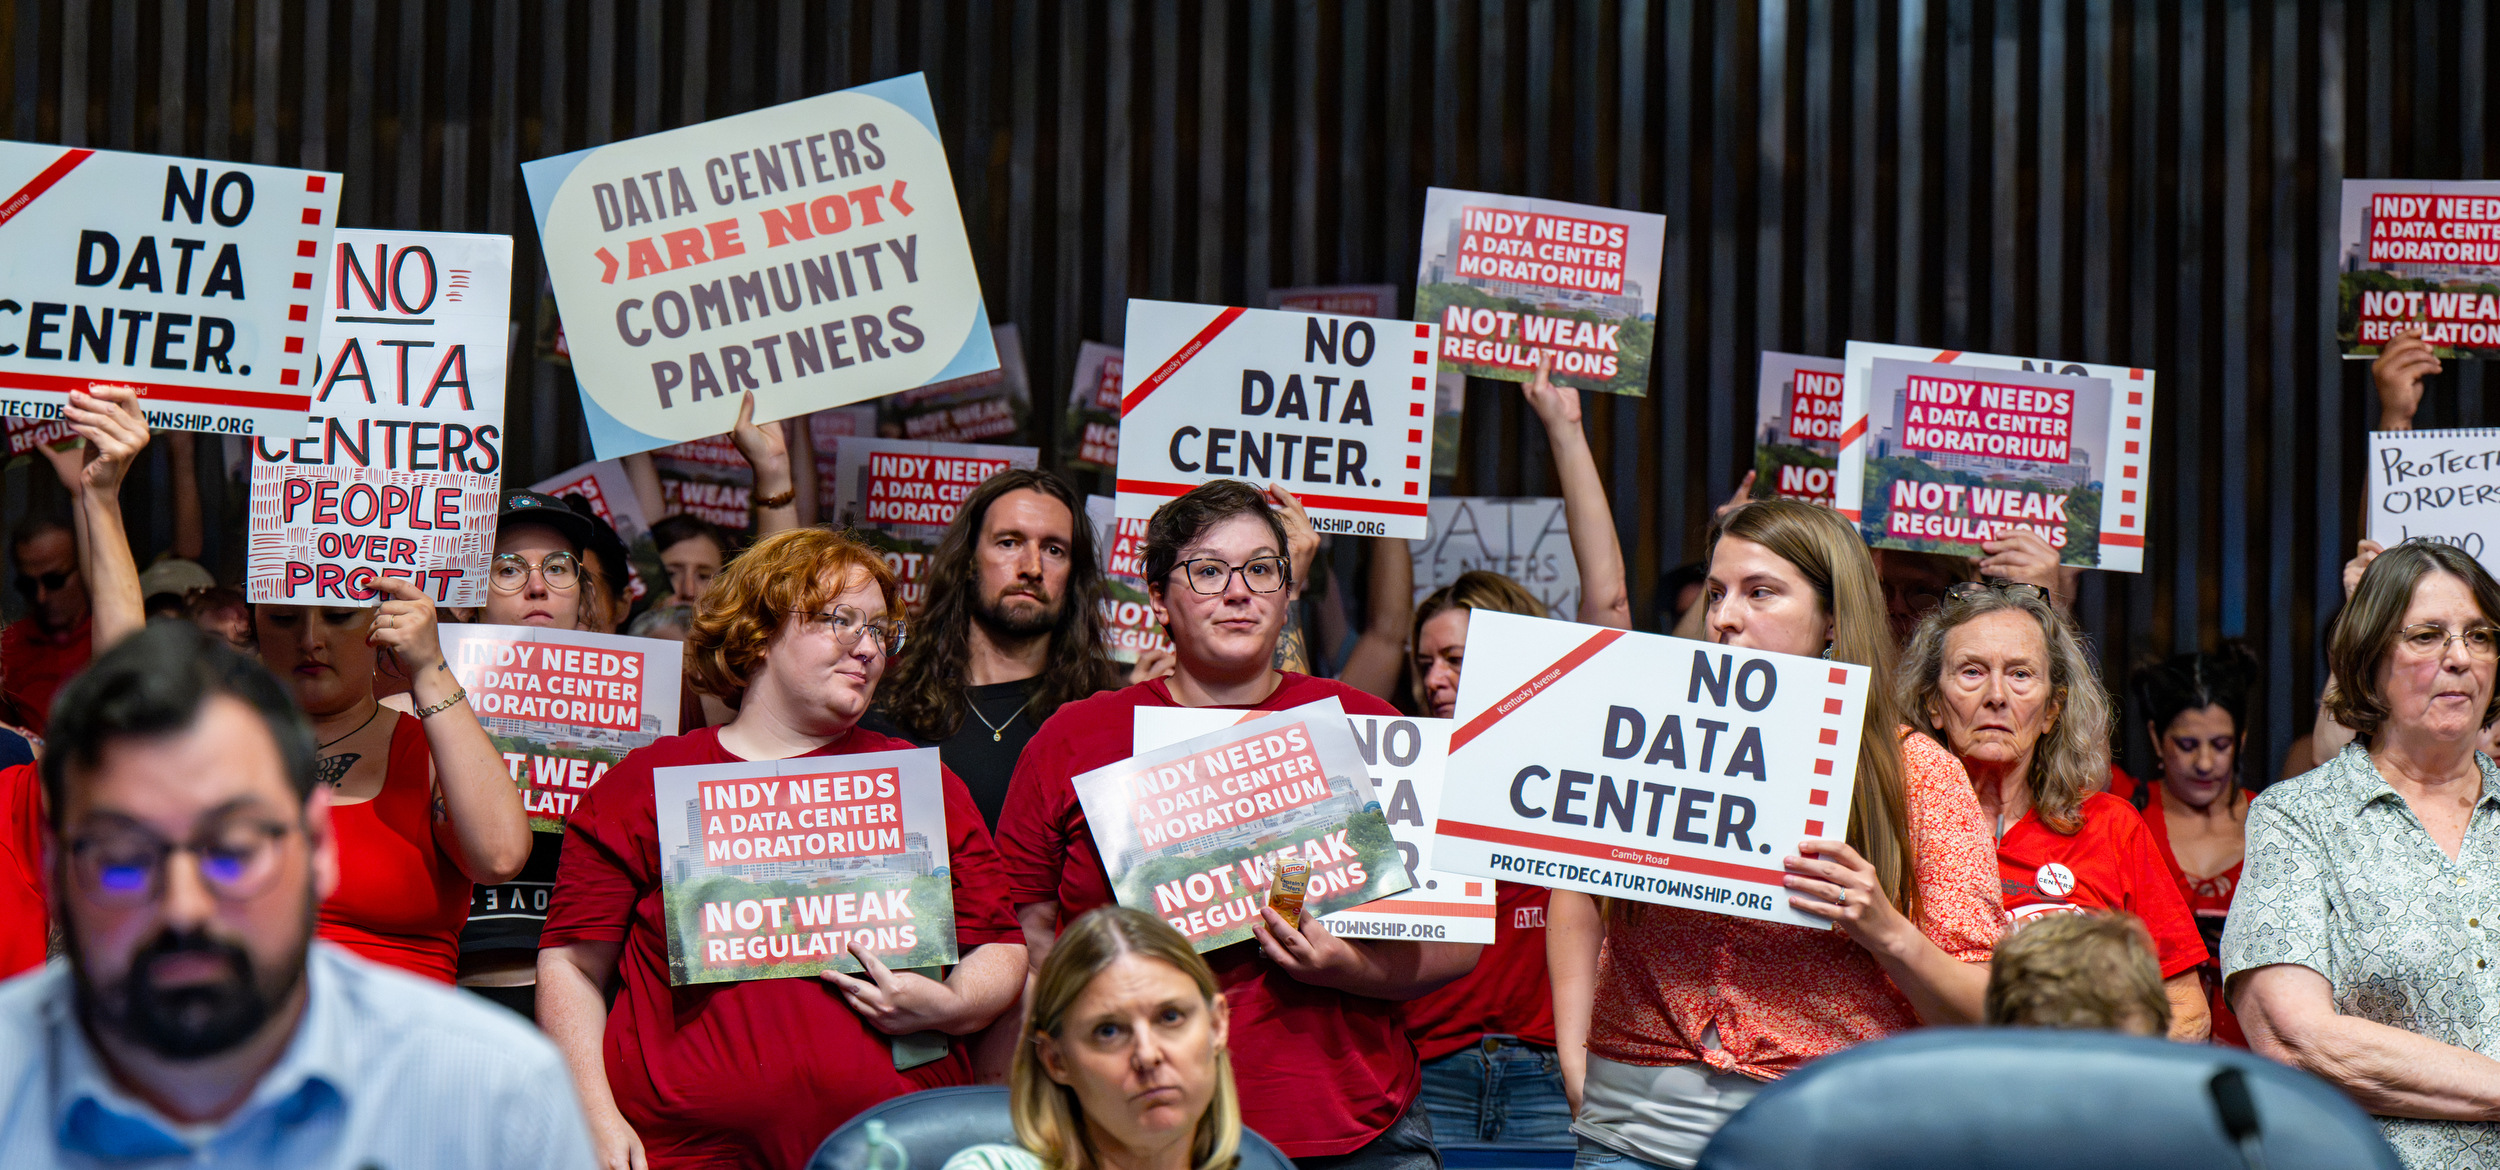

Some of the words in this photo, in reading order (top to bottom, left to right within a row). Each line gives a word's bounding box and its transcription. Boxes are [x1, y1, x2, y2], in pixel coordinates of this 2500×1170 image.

[593, 166, 697, 232] DATA
[705, 122, 886, 205] CENTERS
[162, 165, 255, 228] NO
[2374, 197, 2432, 218] INDY
[627, 217, 746, 281] ARE
[760, 184, 886, 248] NOT
[1464, 210, 1530, 236] INDY
[1535, 217, 1624, 249] NEEDS
[2373, 221, 2387, 238] A
[2390, 222, 2437, 239] DATA
[75, 229, 246, 301] DATA
[1463, 235, 1478, 251] A
[1483, 237, 1534, 258] DATA
[1539, 243, 1621, 269] CENTER
[2372, 241, 2500, 262] MORATORIU
[336, 242, 438, 315] NO
[615, 234, 919, 347] COMMUNITY
[1460, 255, 1621, 291] MORATORIUM
[2364, 290, 2424, 318] NOT
[2429, 292, 2500, 320] WEA
[1305, 316, 1376, 367] NO
[1446, 305, 1518, 338] NOT
[1523, 314, 1620, 351] WEAK
[312, 337, 475, 411] ATA
[651, 305, 925, 409] PARTNERS
[1152, 358, 1181, 384] Kentucky
[1179, 340, 1202, 361] Avenue
[1241, 369, 1374, 426] DATA
[1796, 372, 1844, 397] IND
[1909, 379, 1976, 406] INDY
[1980, 386, 2070, 415] NEEDS
[1795, 397, 1809, 414] A
[1813, 399, 1843, 417] DA
[1908, 405, 1924, 423] A
[1928, 407, 1980, 429] DATA
[1985, 412, 2068, 437] CENTER
[1169, 426, 1381, 488] CENTER.
[1906, 426, 2067, 460] MORATORIUM
[872, 456, 930, 480] INDY
[283, 478, 462, 530] PEOPLE
[871, 480, 885, 497] A
[889, 482, 935, 500] DATA
[1894, 479, 1966, 512] NOT
[1971, 486, 2069, 523] WEAK
[869, 500, 958, 523] MORATO
[318, 533, 417, 565] OVER
[1116, 537, 1130, 553] A
[463, 643, 535, 669] INDY
[542, 648, 639, 679] NEEDS
[463, 671, 478, 687] A
[484, 671, 541, 692] DATA
[547, 676, 637, 702] CENTER
[1496, 687, 1534, 715] Kentucky
[1532, 667, 1562, 691] Avenue
[1687, 649, 1777, 713] NO
[467, 693, 637, 727] MORATORIUM
[1347, 718, 1421, 767] NO
[1602, 705, 1768, 782] DATA
[1124, 760, 1196, 800] INDY
[1204, 728, 1308, 777] NEEDS
[703, 781, 780, 811] INDY
[788, 773, 895, 805] NEEDS
[1139, 804, 1155, 823] A
[1157, 785, 1219, 816] DATA
[1222, 755, 1317, 796] CENTER
[707, 816, 725, 835] A
[731, 811, 794, 833] DATA
[798, 803, 898, 829] CENTER
[1142, 776, 1326, 847] MORATORIUM
[1509, 764, 1773, 855] CENTER.
[708, 828, 900, 862] MORATORIUM
[1611, 849, 1643, 865] Camby
[1645, 853, 1669, 866] Road
[1155, 864, 1235, 913] NOT
[1282, 865, 1305, 874] Lance
[1490, 853, 1773, 911] PROTECTDECATURTOWNSHIP.ORG
[2038, 877, 2073, 889] CENTERS
[2047, 871, 2067, 880] DATA
[704, 897, 788, 933] NOT
[795, 888, 915, 927] WEAK
[1167, 862, 1368, 937] REGULONS
[1514, 906, 1545, 928] ATL
[708, 925, 918, 962] REGULATIONS
